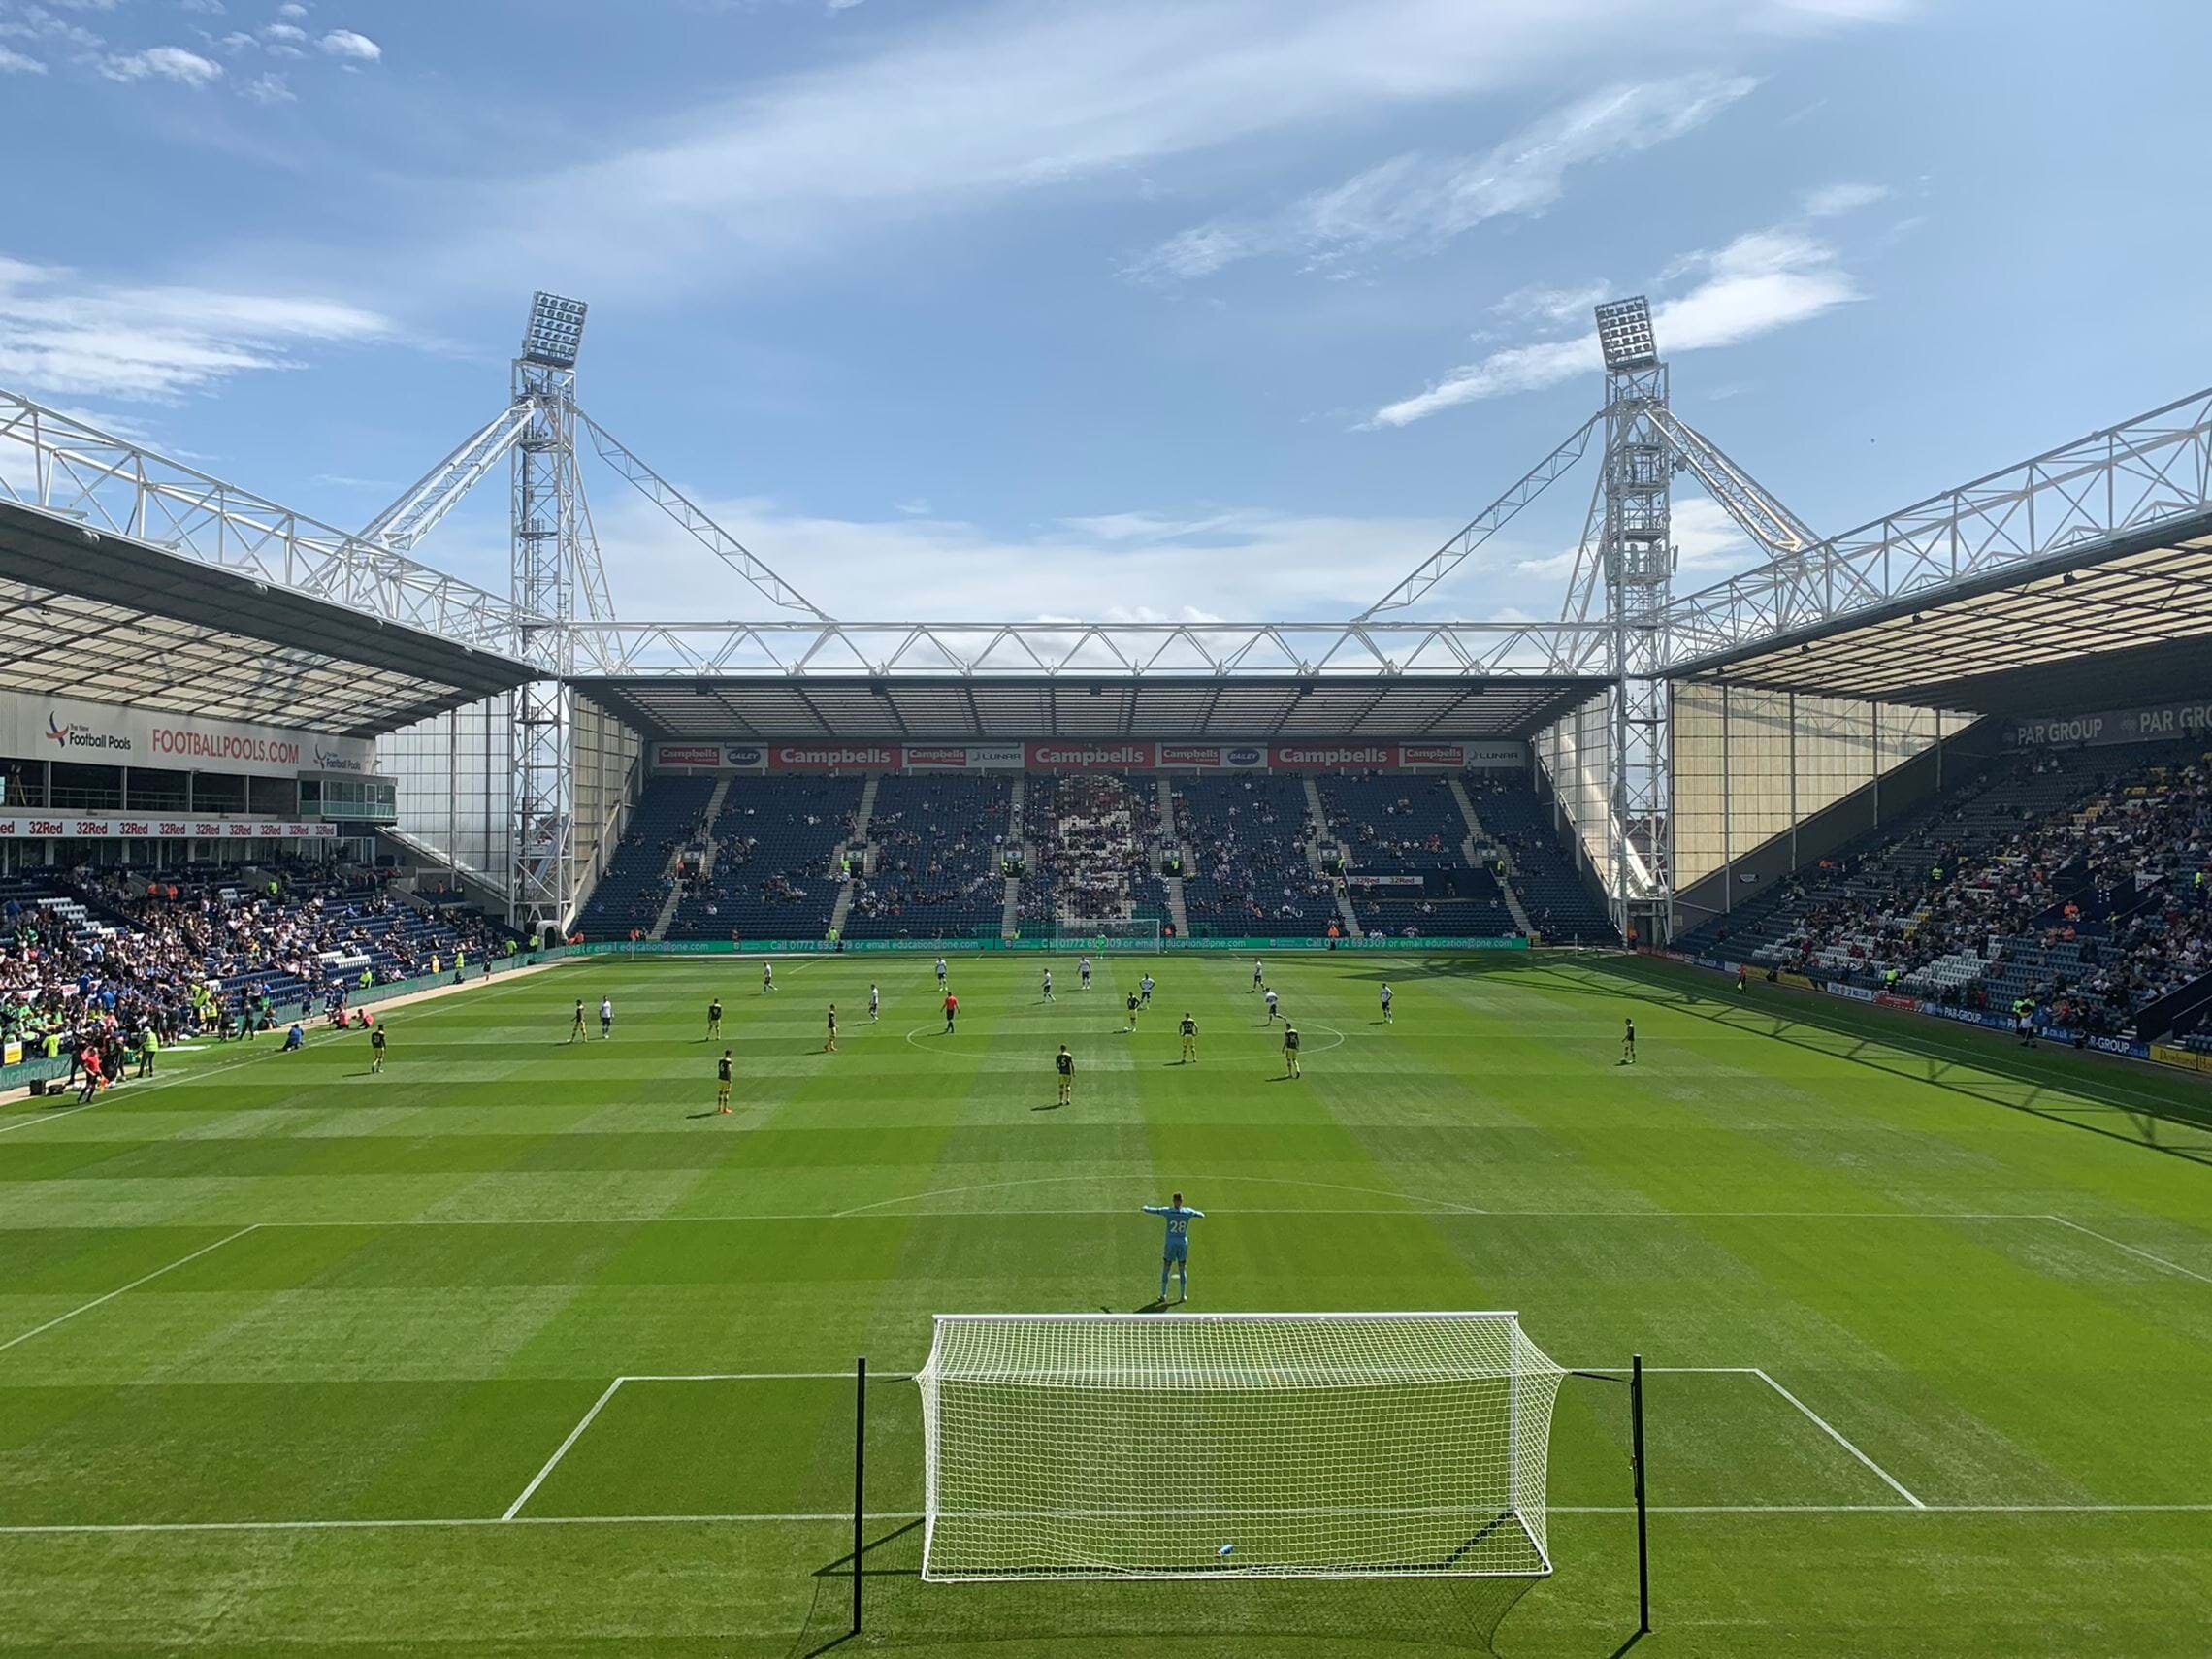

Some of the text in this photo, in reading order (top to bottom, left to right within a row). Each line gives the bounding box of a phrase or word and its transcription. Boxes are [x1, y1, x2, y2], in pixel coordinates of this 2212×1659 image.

[2140, 710, 2174, 732] PAR
[2018, 719, 2103, 745] PAR GROUP
[70, 732, 131, 750] Football Pools
[152, 729, 299, 764] FOOTBALLPOOLS.COM
[661, 749, 718, 759] Campbells
[780, 748, 891, 766] Campbells
[909, 750, 964, 759] Campbells
[1035, 747, 1144, 766] Campbells
[1163, 749, 1218, 759] Campbells
[1279, 747, 1387, 766] Campbells
[1406, 749, 1461, 758] Campbells
[29, 821, 63, 834] 32Red
[76, 822, 107, 834] 32Red
[119, 822, 148, 834] 32Red
[159, 823, 185, 835] 32Red
[195, 823, 219, 835] 32Red
[229, 824, 252, 835] 32Red
[260, 825, 281, 835] 32Red
[289, 825, 309, 835] 32Red
[315, 825, 334, 835] 32Red
[619, 941, 708, 953] education@pne.com
[770, 941, 788, 950] Call
[790, 941, 814, 950] 01772
[866, 940, 890, 950] email
[892, 940, 978, 951] education@pne.com
[1060, 938, 1085, 948] 01772
[1305, 938, 1321, 947] Call
[1324, 938, 1350, 947] 0772
[1351, 938, 1386, 947] 693309
[1400, 938, 1423, 948] email
[1425, 938, 1512, 949] education@pne.com
[1170, 1220, 1187, 1233] 28
